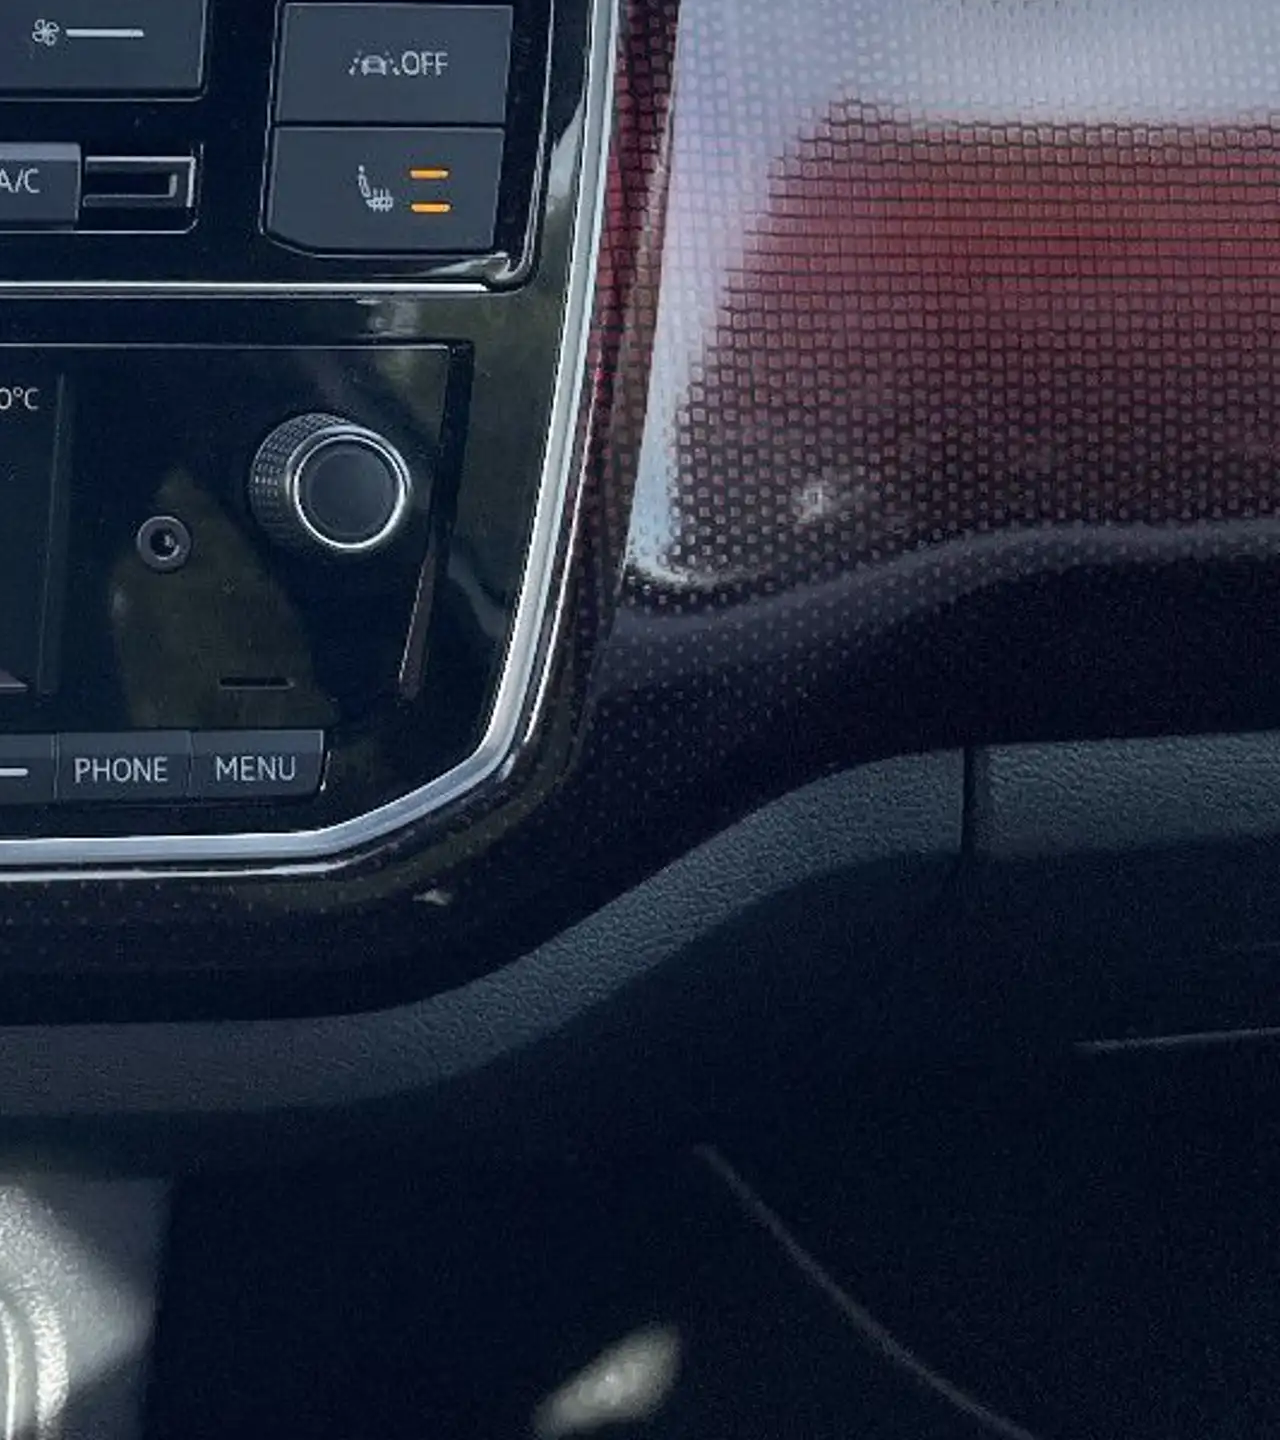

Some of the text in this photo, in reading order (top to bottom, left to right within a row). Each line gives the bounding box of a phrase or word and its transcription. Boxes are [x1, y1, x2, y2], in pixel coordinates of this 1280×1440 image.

[401, 50, 448, 76] OFF
[74, 756, 169, 784] PHONE
[216, 755, 297, 782] MENU
